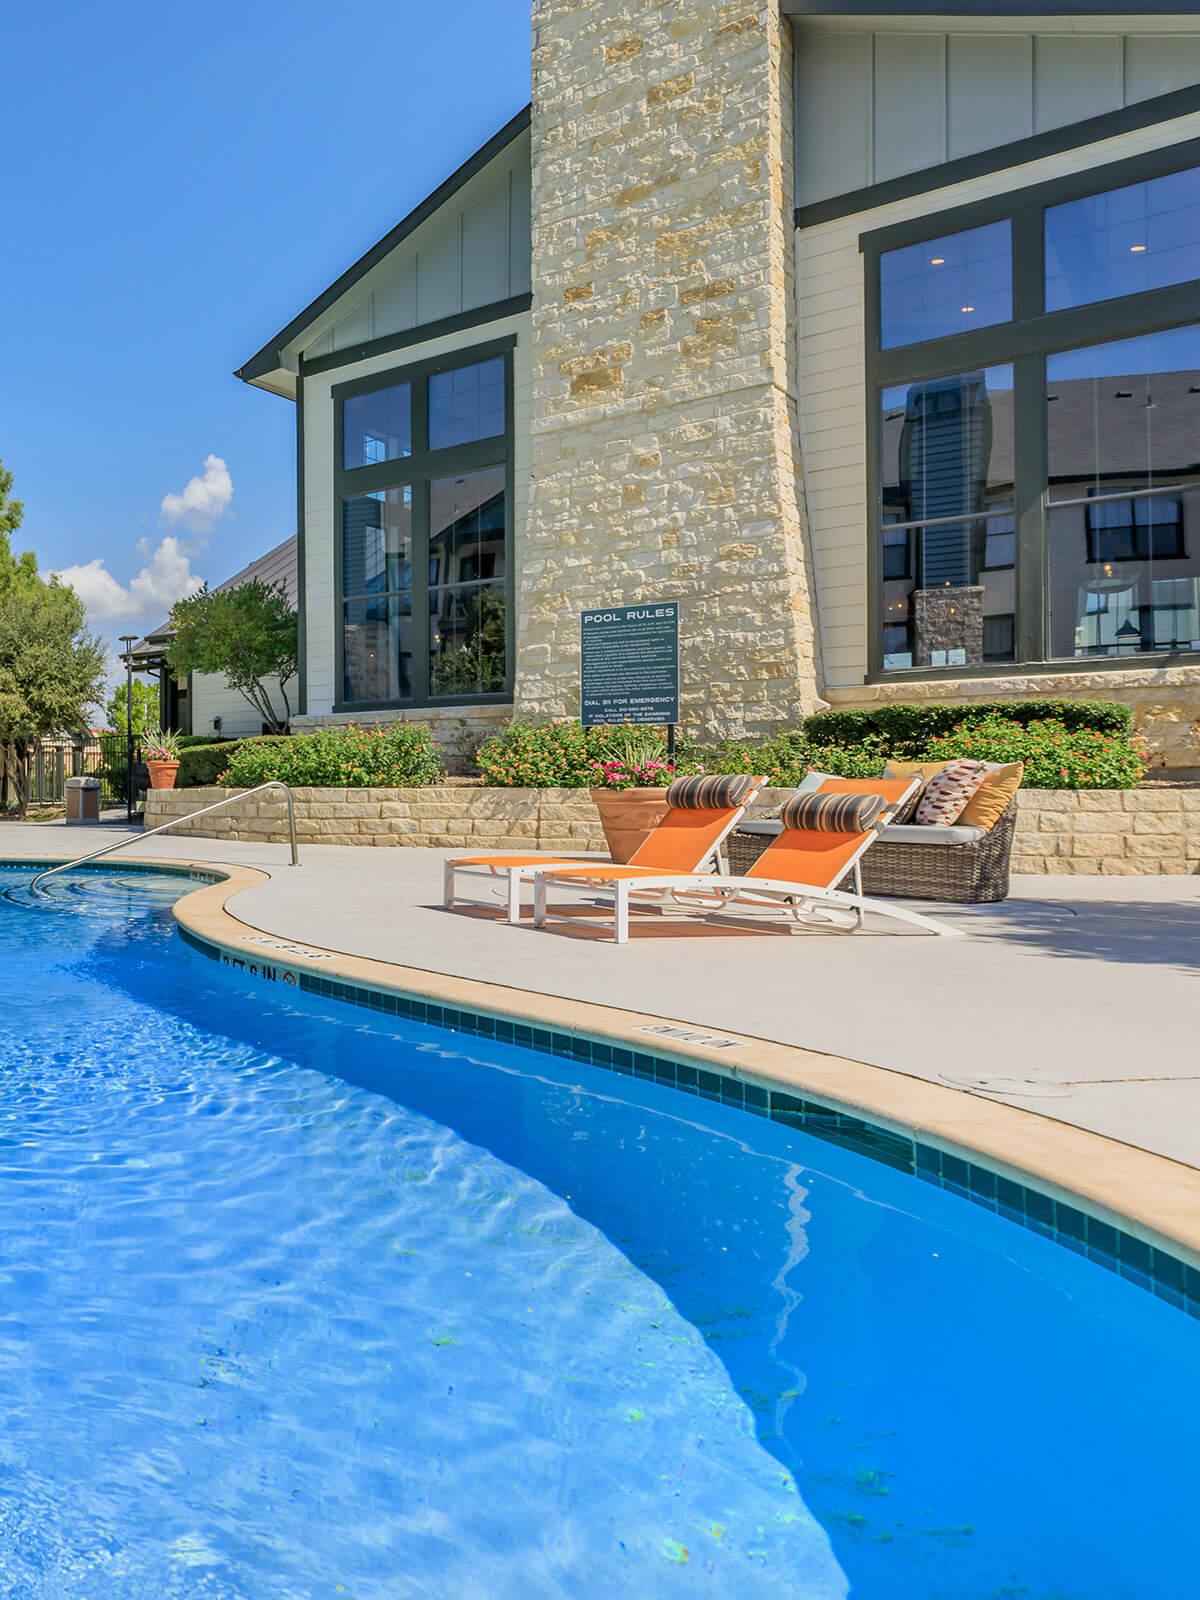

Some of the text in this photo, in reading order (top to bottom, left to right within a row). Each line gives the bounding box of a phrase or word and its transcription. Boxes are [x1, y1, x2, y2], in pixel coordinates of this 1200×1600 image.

[584, 608, 675, 624] POOL RULES
[629, 696, 675, 705] EMERGENCY
